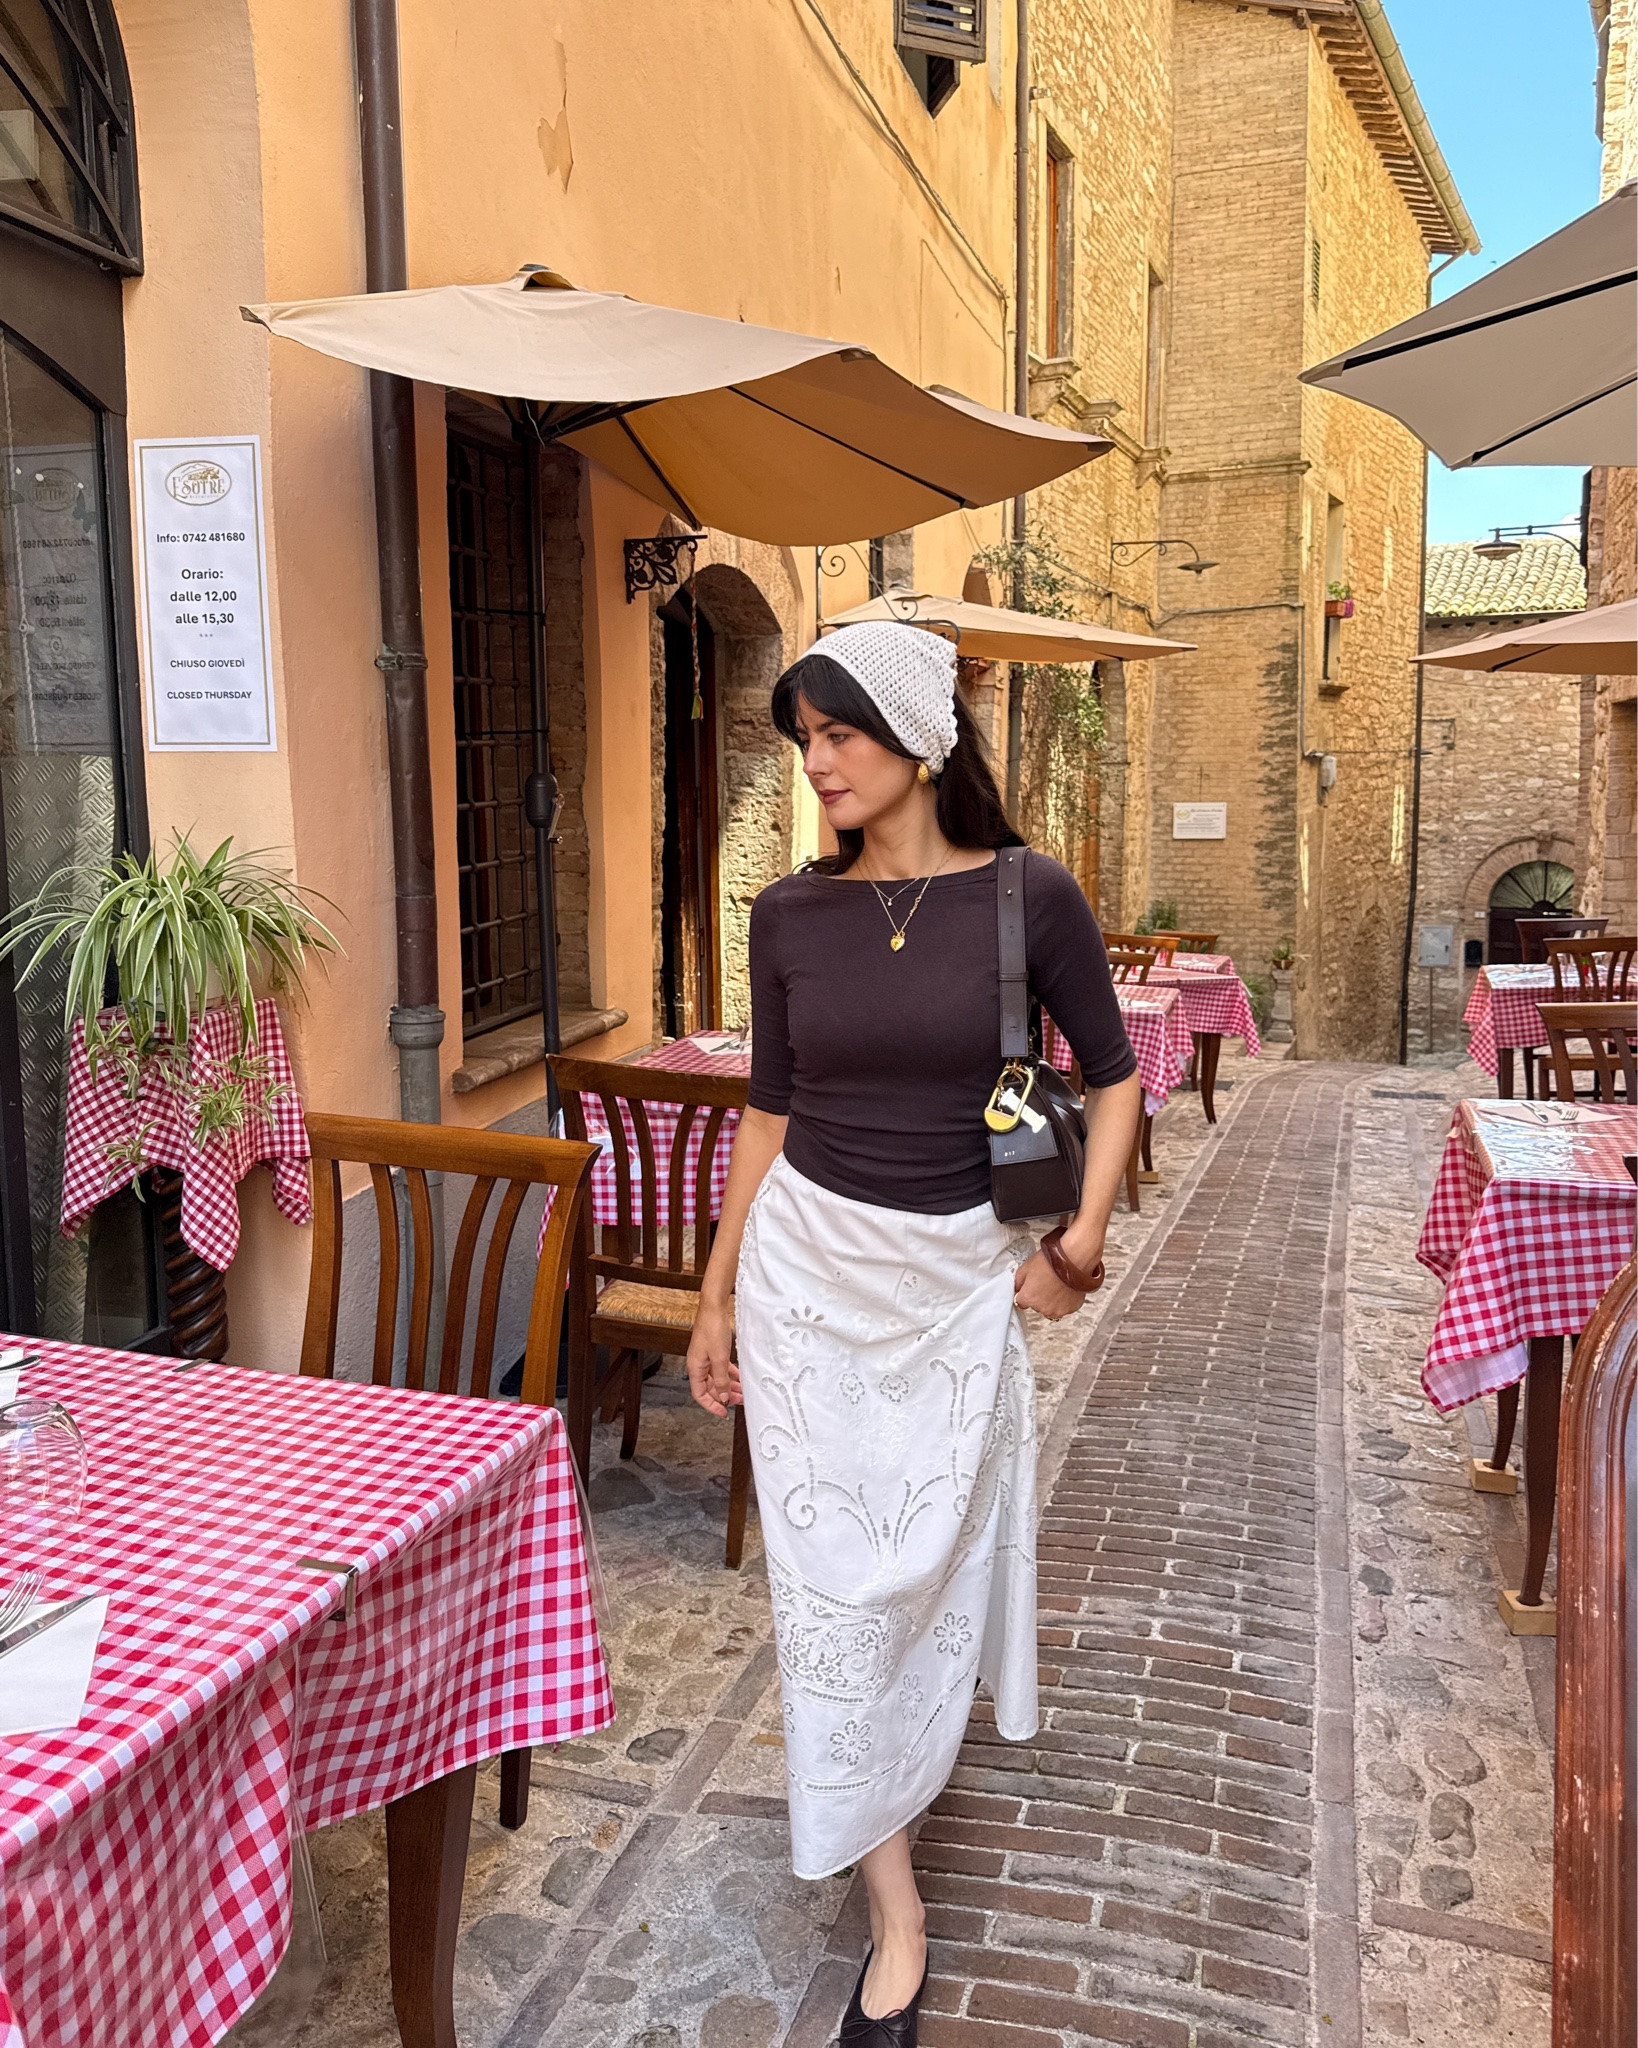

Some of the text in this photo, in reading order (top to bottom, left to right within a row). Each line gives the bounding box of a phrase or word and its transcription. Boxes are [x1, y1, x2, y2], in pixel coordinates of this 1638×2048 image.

[156, 532, 246, 543] Info: 0742 481680
[181, 568, 224, 580] Orario:
[170, 590, 237, 603] dalle 12,00
[175, 612, 235, 626] alle 15,30
[169, 657, 246, 668] CHIUSO GIOVEDÌ
[166, 690, 253, 700] CLOSED THURSDAY
